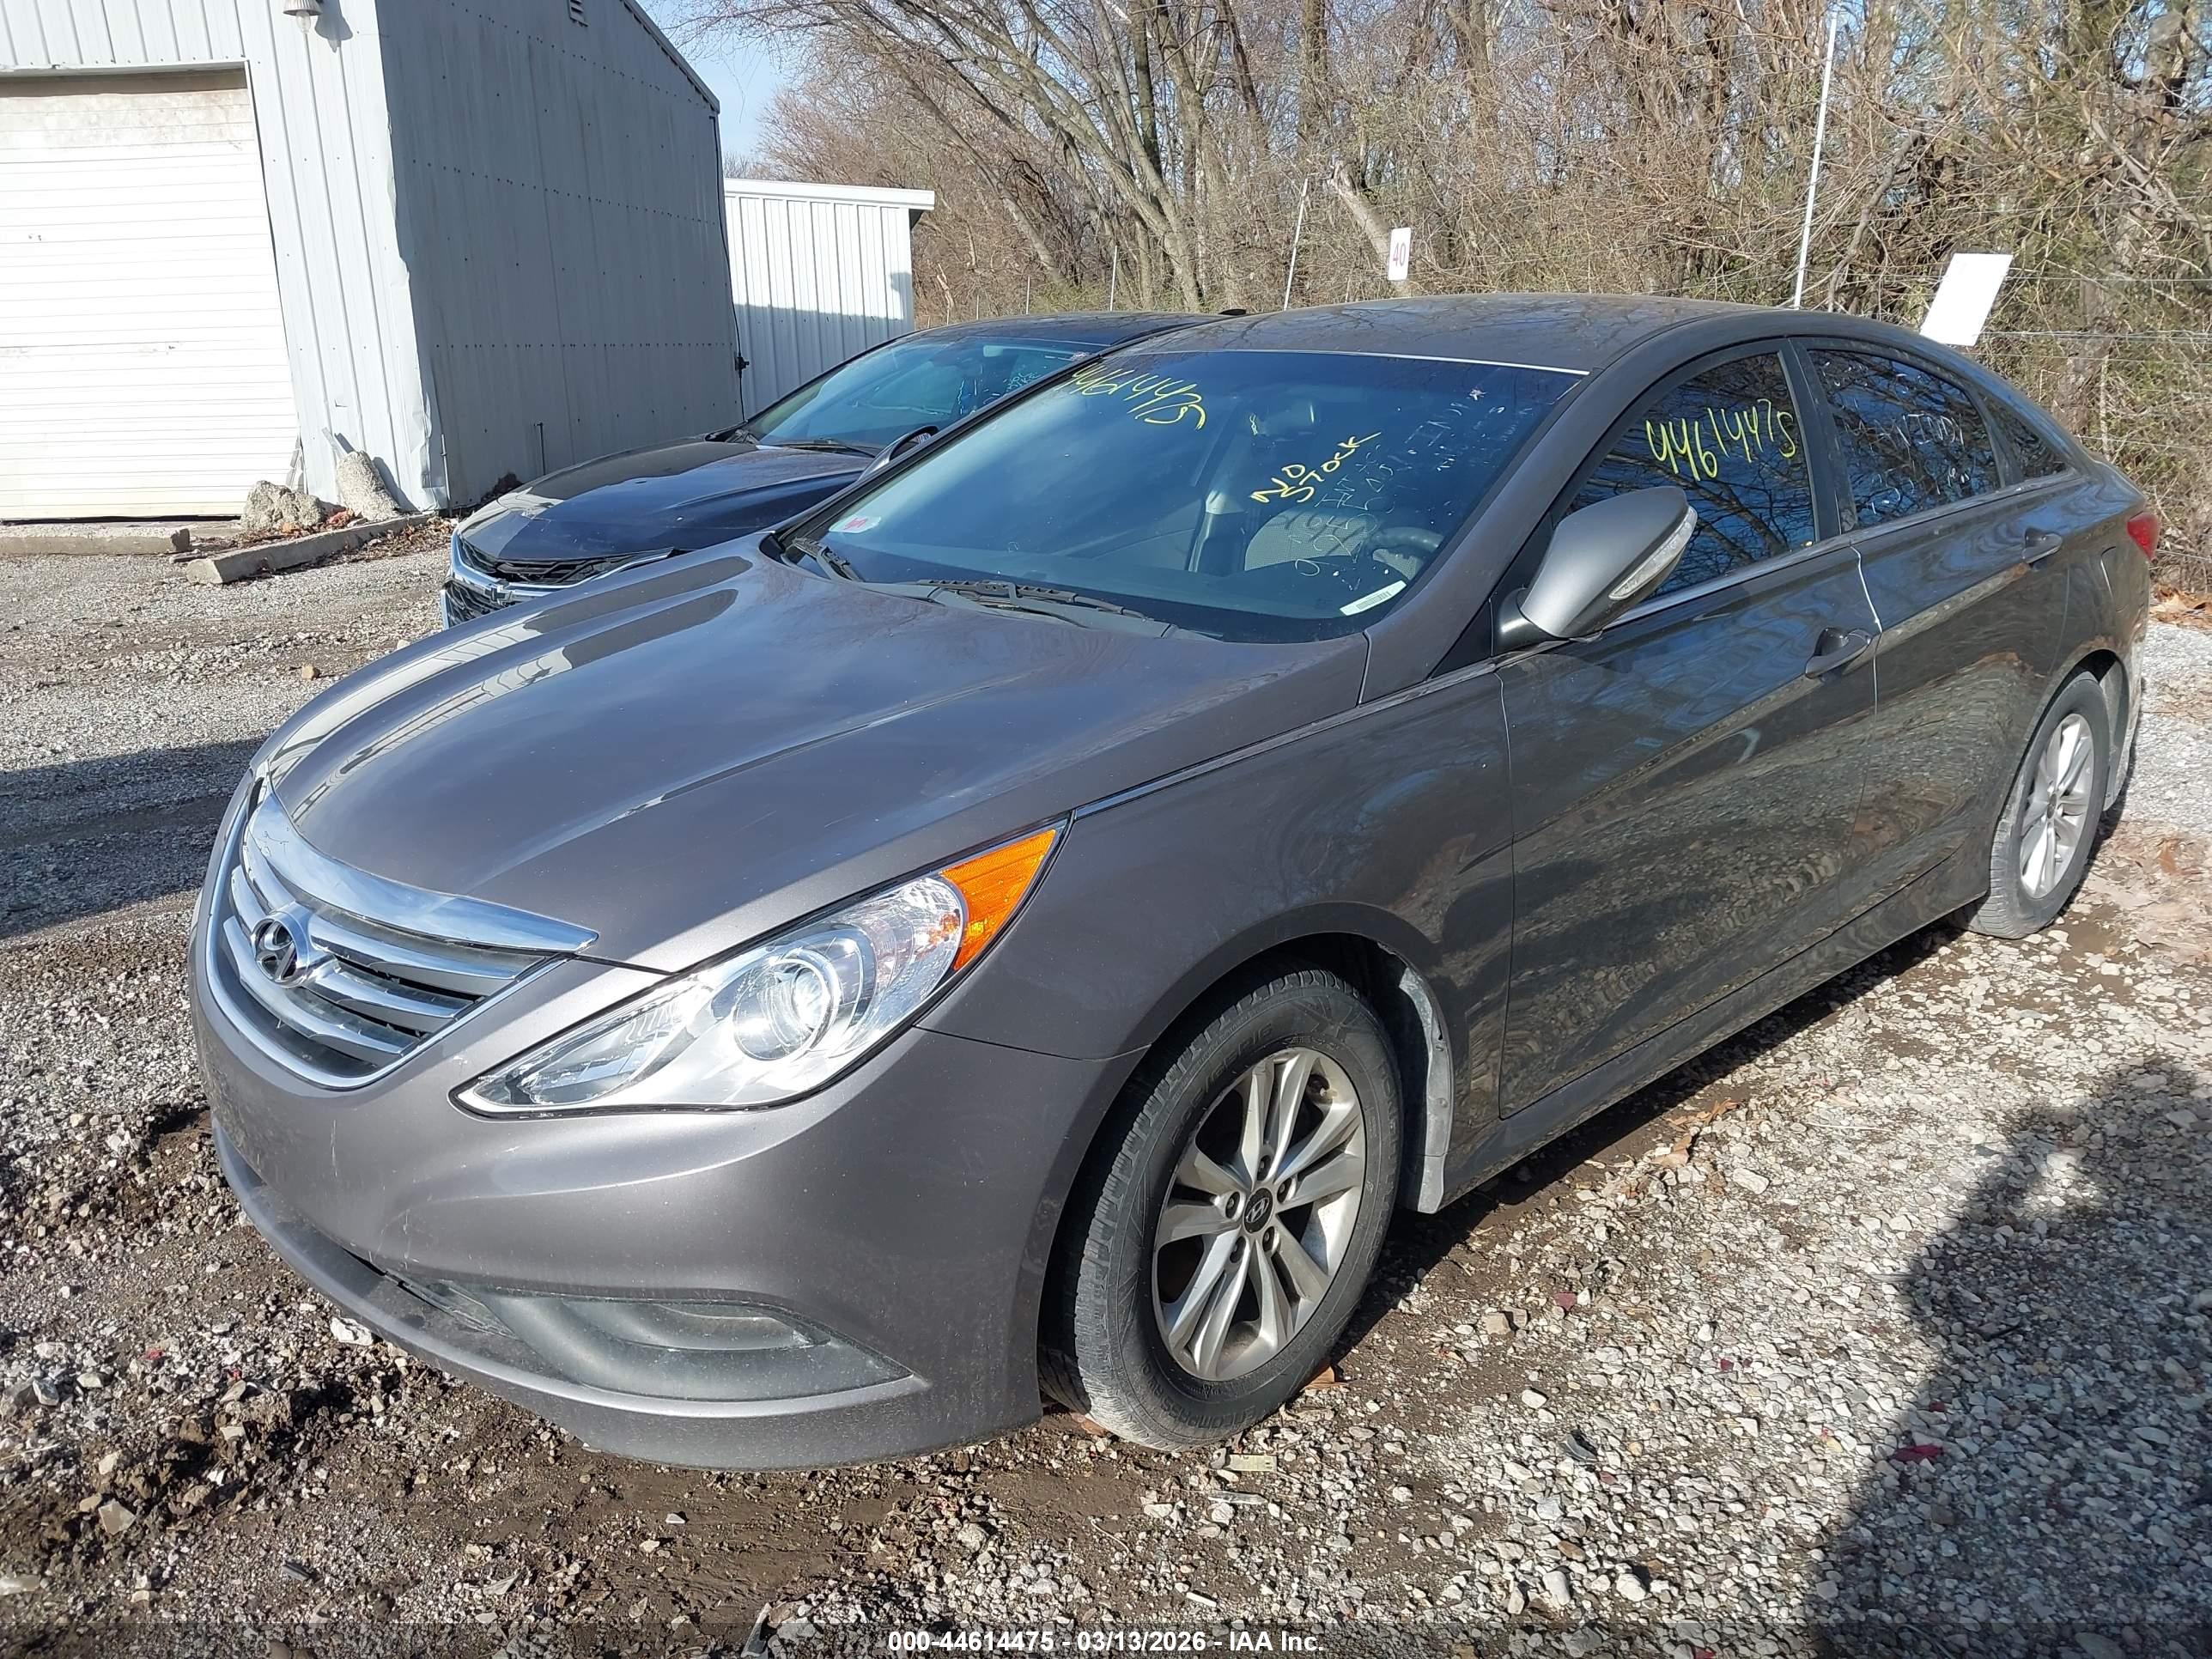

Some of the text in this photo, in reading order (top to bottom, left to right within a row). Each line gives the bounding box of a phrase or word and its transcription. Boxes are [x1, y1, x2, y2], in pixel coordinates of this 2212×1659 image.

[1392, 242, 1407, 267] 40
[1645, 398, 1796, 482] 44614475
[1250, 464, 1306, 503] NO
